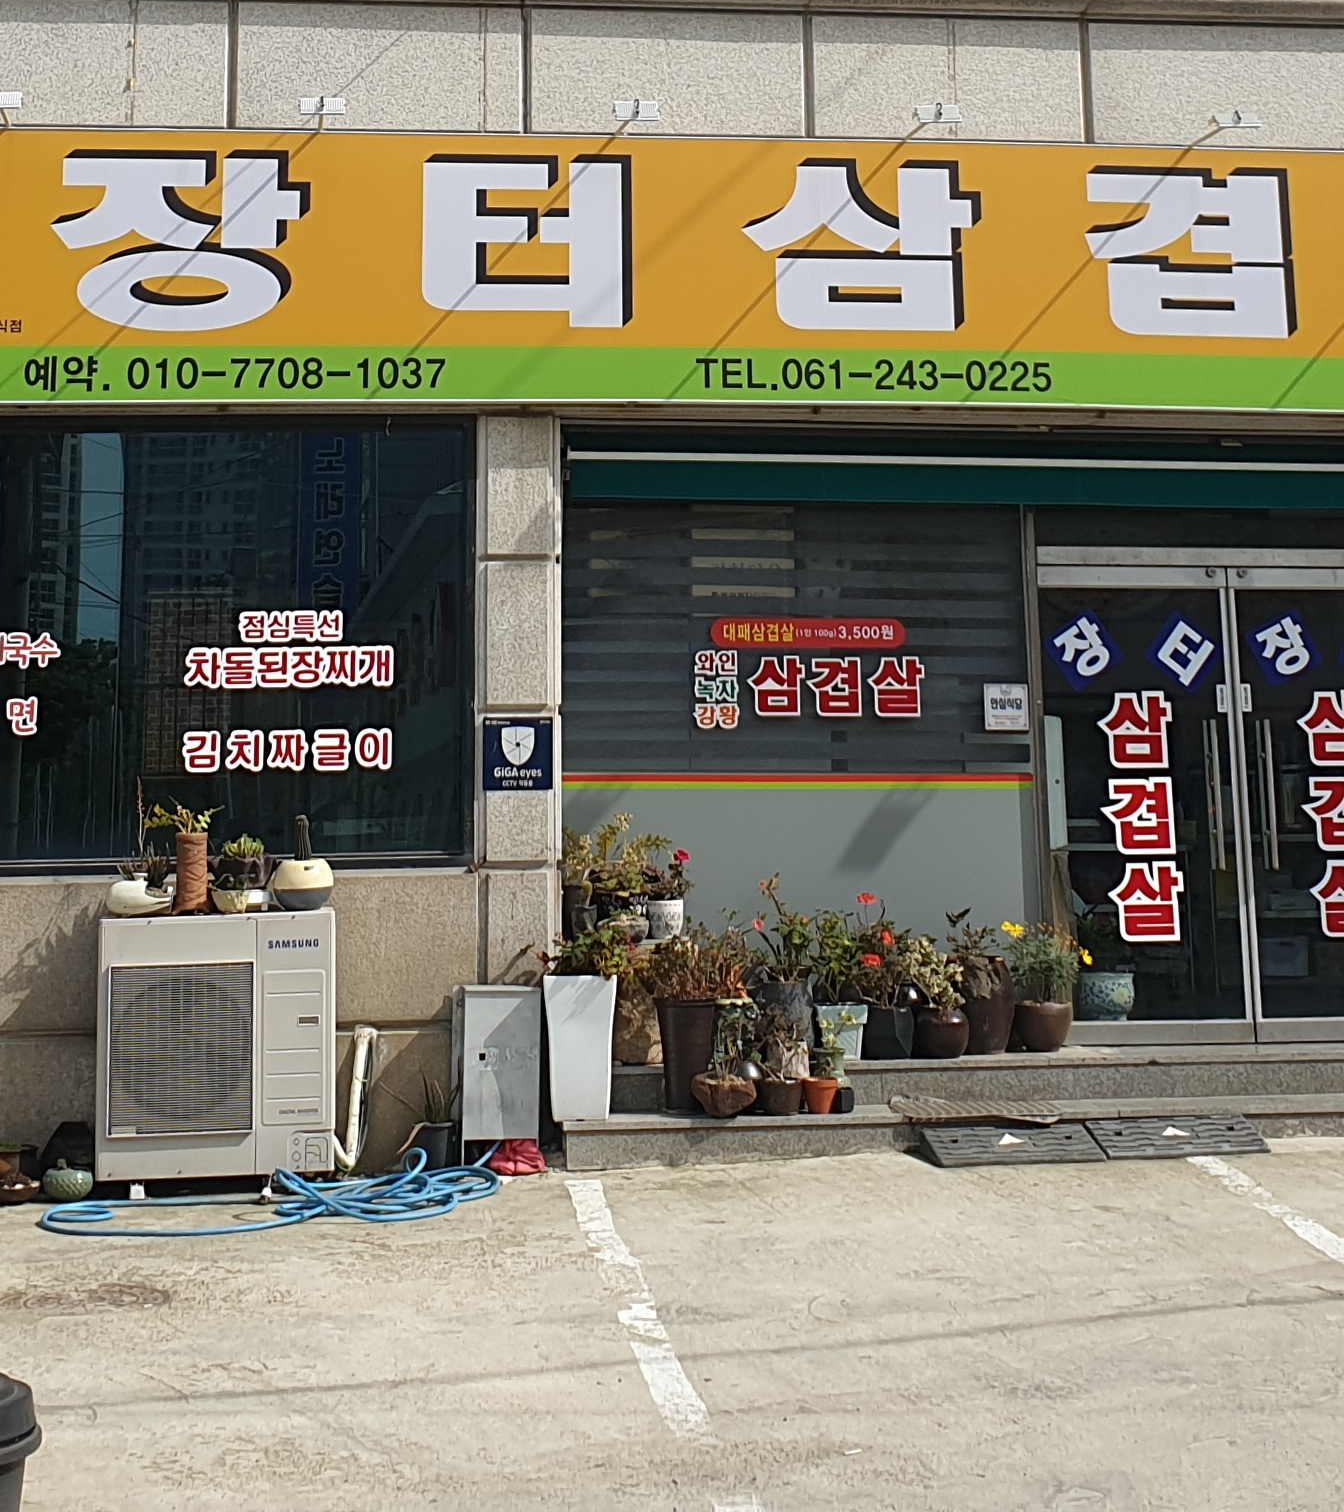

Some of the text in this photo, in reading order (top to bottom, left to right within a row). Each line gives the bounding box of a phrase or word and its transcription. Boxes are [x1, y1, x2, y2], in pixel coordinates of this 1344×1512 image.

[126, 356, 446, 391] 010-7708-1037
[239, 610, 344, 642] 점심특선
[184, 646, 394, 688] 차돌된장찌개
[694, 650, 738, 675] 와인
[695, 676, 738, 702] 녹차
[748, 655, 924, 718] 삼겹살
[694, 703, 739, 730] 강황
[183, 728, 392, 773] 김치짜글이
[1097, 690, 1184, 942] 삼겹살
[268, 938, 319, 949] SAMSUNG
